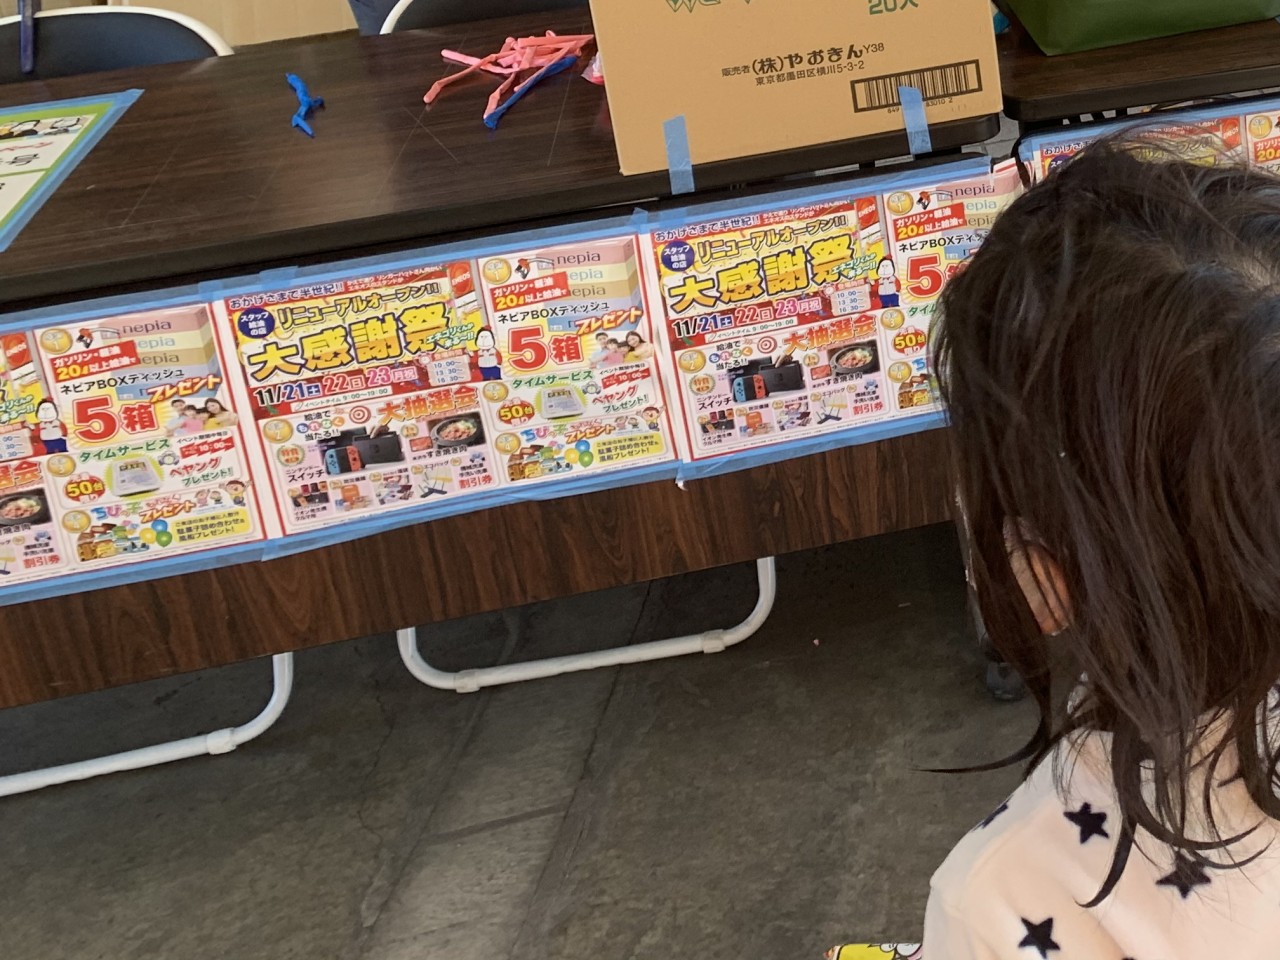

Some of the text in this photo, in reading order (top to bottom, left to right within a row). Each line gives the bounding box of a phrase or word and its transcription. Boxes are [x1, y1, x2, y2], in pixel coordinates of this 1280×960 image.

[721, 42, 886, 78] 販売者 (株)やおきん Y38
[754, 60, 866, 87] 東京都墨田区横川5-3-2
[955, 184, 996, 198] nepia
[895, 207, 952, 229] ガソリン・軽油
[655, 215, 760, 242] おかげさまで半世紀!!
[697, 214, 848, 265] リニューアルオープン!!
[556, 250, 601, 267] nepia
[663, 244, 690, 257] スタッフ
[668, 233, 855, 315] 大感謝祭
[672, 259, 688, 270] の店
[229, 281, 345, 309] おかげさまで半世紀!!
[493, 278, 554, 298] ガソリン・軽油
[278, 281, 440, 329] リニューアルオープン!!
[498, 300, 610, 325] ネピアBOXティッシュ
[122, 319, 172, 336] nepia
[240, 311, 269, 324] スタッフ
[573, 306, 644, 336] プレゼント
[249, 327, 268, 337] の店
[250, 301, 450, 383] 大感謝祭
[783, 314, 878, 356] 大抽選会
[53, 346, 122, 367] ガソリン・軽油
[508, 325, 584, 371] 5箱
[715, 341, 742, 354] 給油で
[715, 357, 750, 371] 当たる!!
[60, 368, 185, 395] ネピアBOXティッシュ
[146, 373, 224, 403] プレゼント
[512, 370, 594, 389] タイムサービス
[377, 385, 480, 426] 大抽選会
[603, 393, 650, 413] プレゼント!
[698, 397, 733, 413] スイッチ
[852, 401, 884, 416] 割引券
[73, 394, 160, 443] 5箱
[303, 408, 332, 422] 給油で
[304, 428, 342, 442] 当たる!!
[520, 424, 569, 443] ちびっ子
[564, 423, 617, 445] プレゼント
[79, 438, 171, 463] タイムサービス
[181, 467, 234, 487] プレゼント!
[287, 469, 326, 484] スイッチ
[458, 474, 493, 490] 割引券
[90, 502, 144, 521] ちびっ子
[139, 499, 197, 525] プレゼント
[22, 554, 61, 570] 割引券
